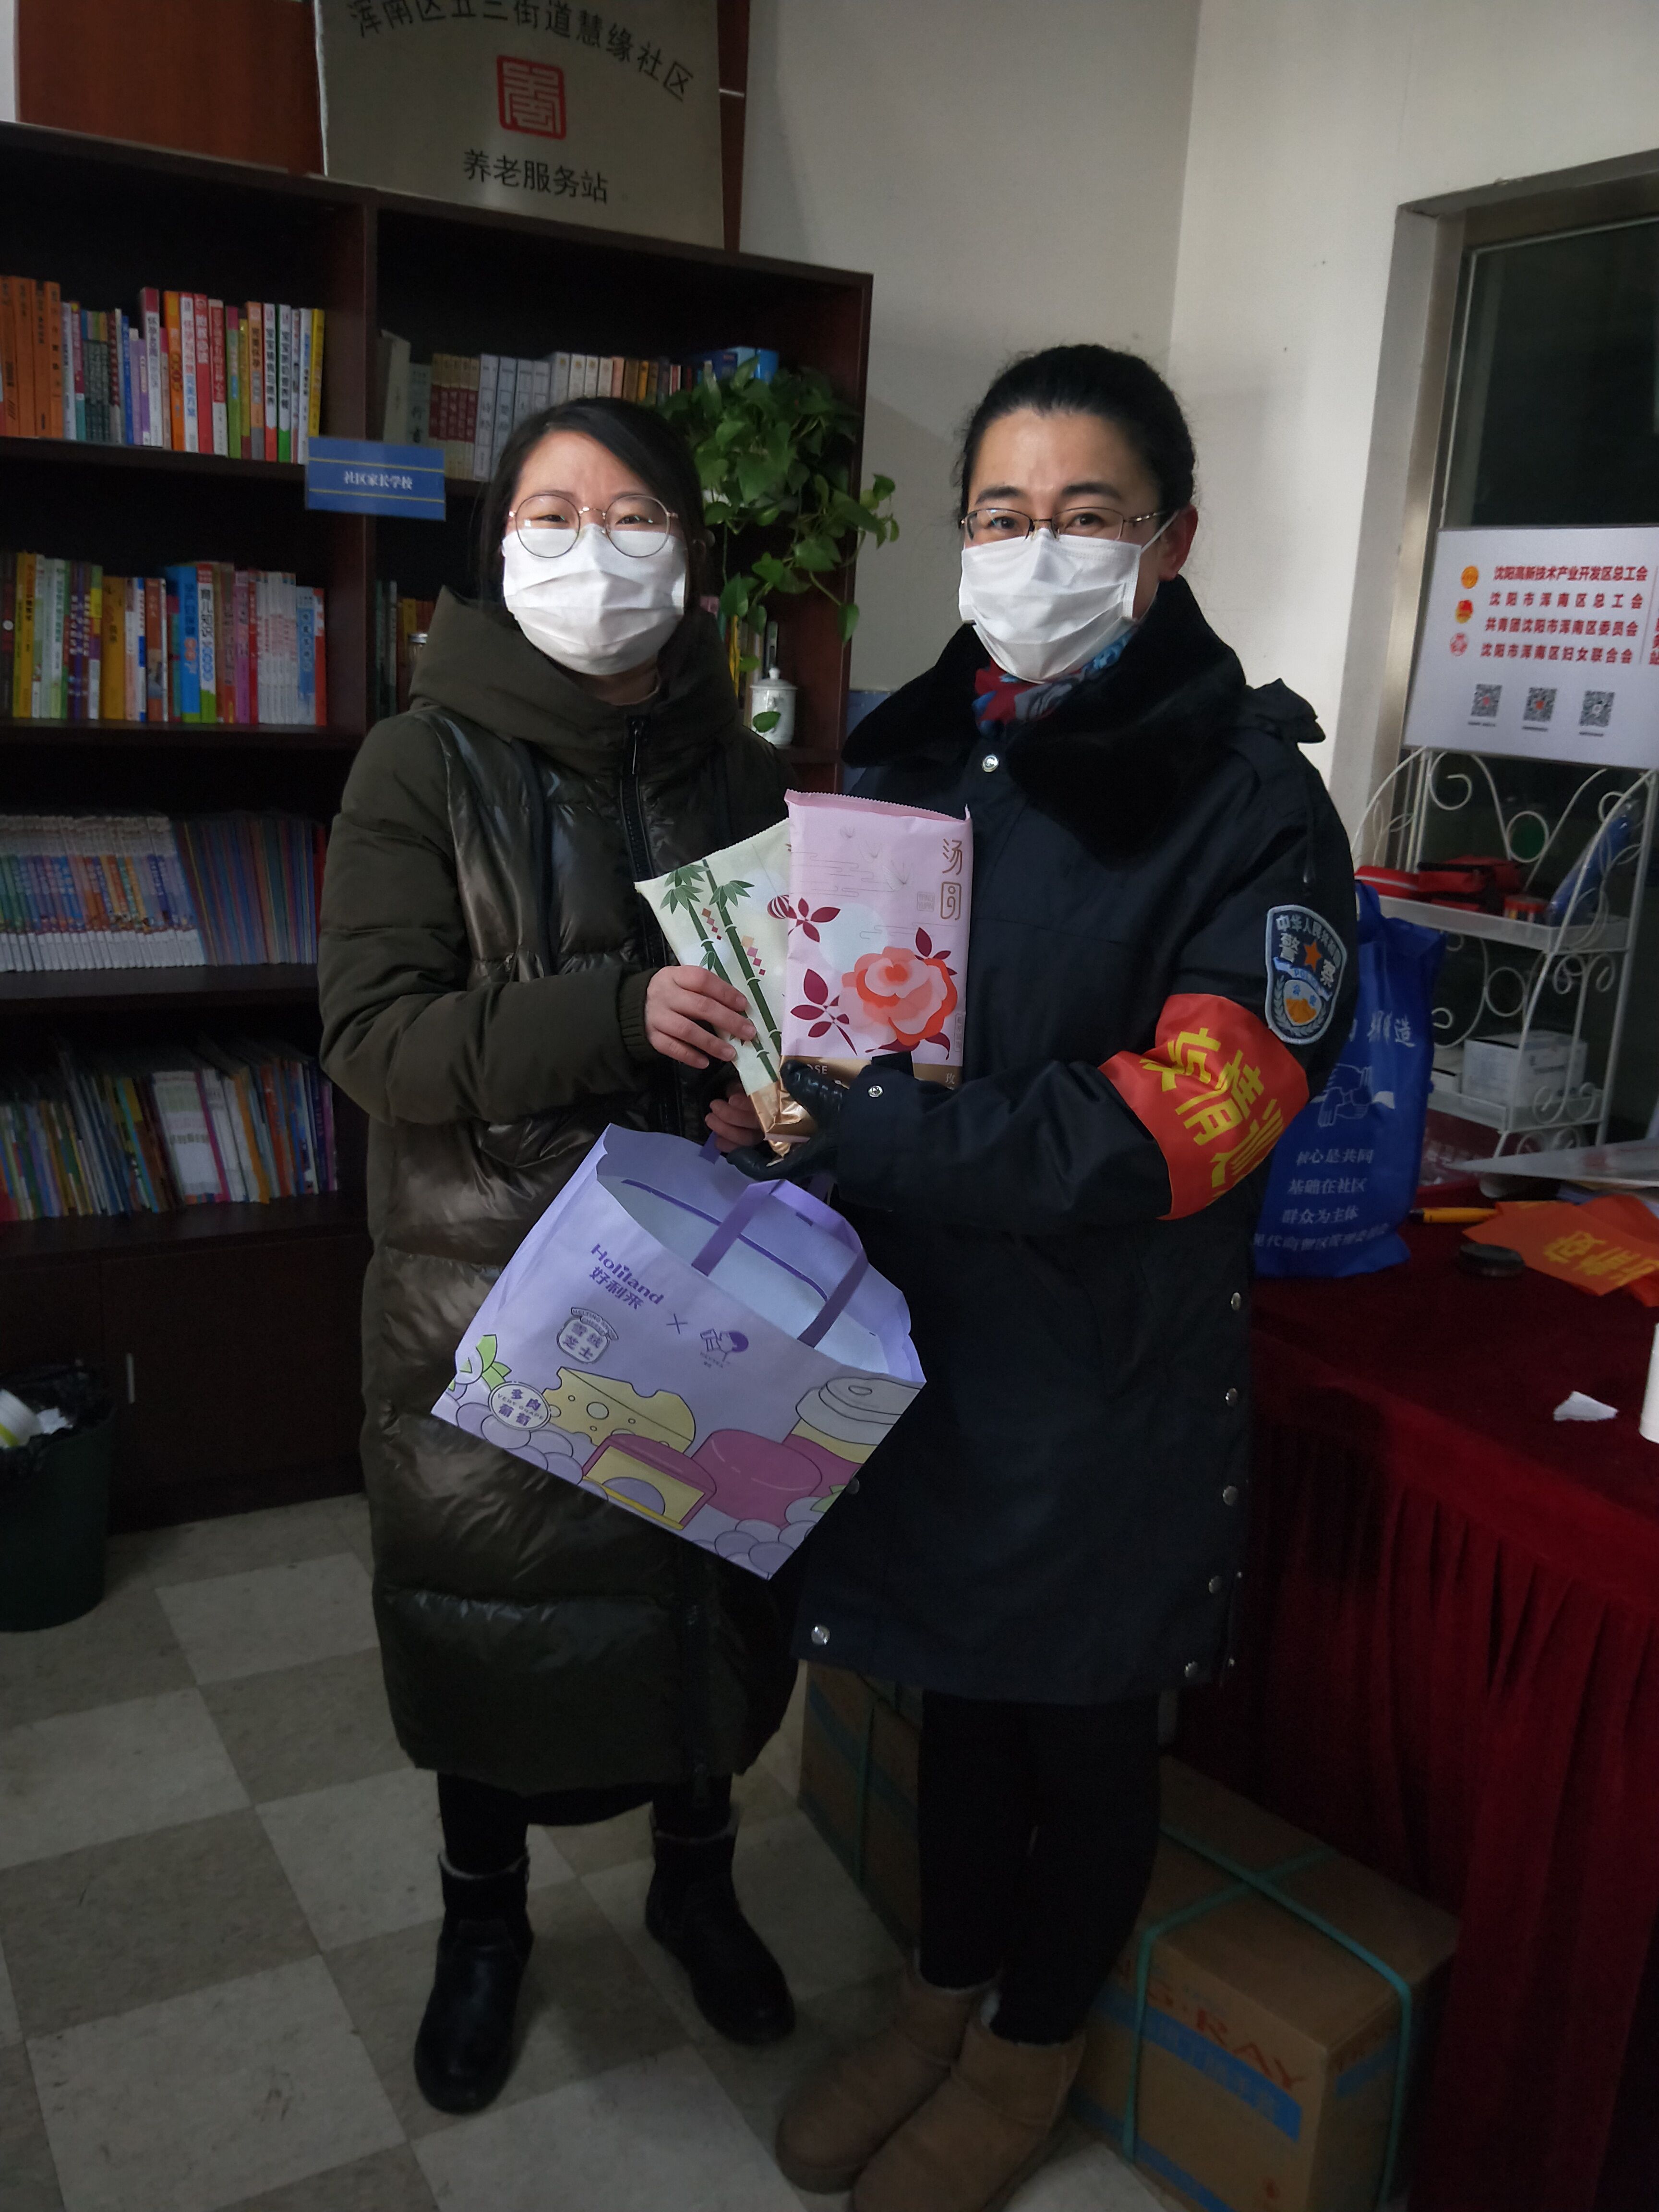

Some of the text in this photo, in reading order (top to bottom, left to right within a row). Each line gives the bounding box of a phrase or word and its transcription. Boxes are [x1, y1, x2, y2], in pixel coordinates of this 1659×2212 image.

[463, 148, 609, 204] 养老服务站
[344, 470, 413, 490] 社区家长学校
[1493, 565, 1648, 582] 沈阳高新技术产业开发区总工会
[1489, 591, 1644, 609] 沈阳市浑南区总工会
[1484, 617, 1639, 637] 共青团沈阳市浑南区委员会
[1480, 642, 1633, 664] 沈阳市浑南区妇女联合会
[1139, 1027, 1284, 1207] 疫情巡
[1296, 1148, 1375, 1166] 核心是共同
[1286, 1177, 1369, 1195] 基础在社区
[1282, 1205, 1359, 1224] 群众为主体
[590, 1243, 665, 1305] Holiland
[589, 1266, 644, 1310] 好利来
[511, 1388, 541, 1411] 多肉
[498, 1403, 531, 1427] 葡萄
